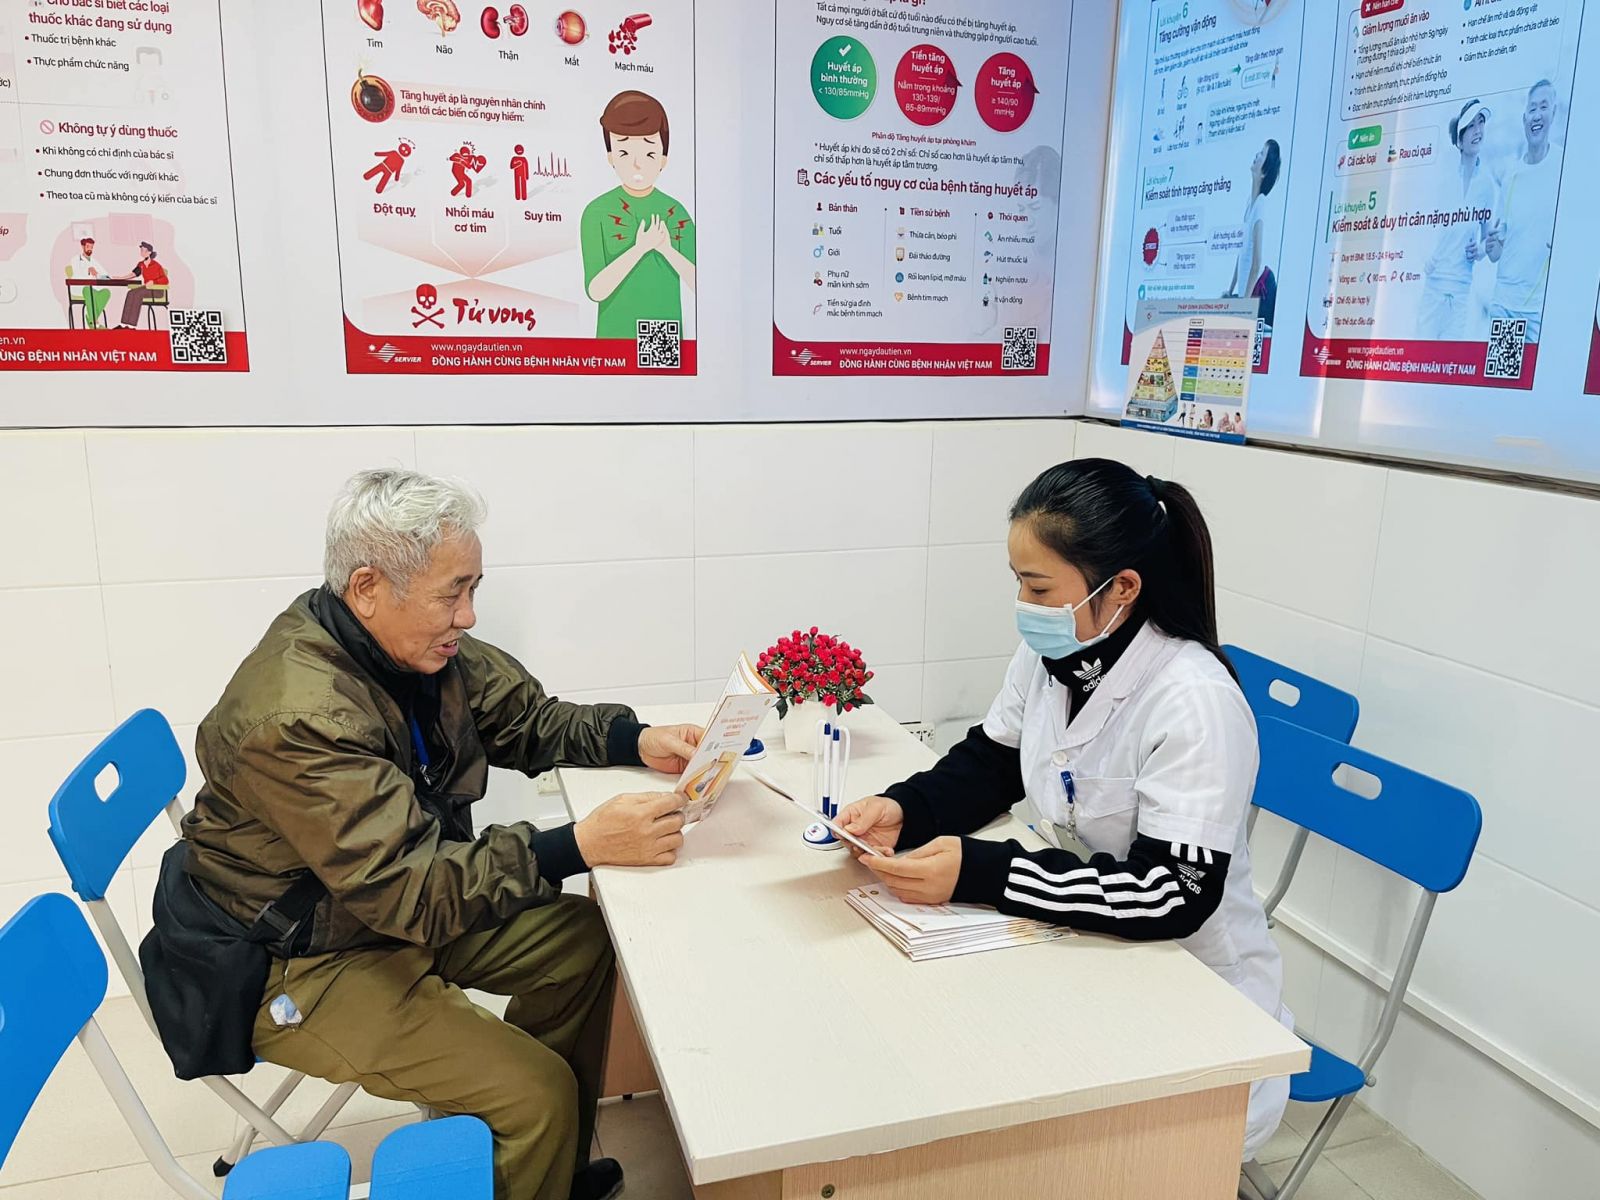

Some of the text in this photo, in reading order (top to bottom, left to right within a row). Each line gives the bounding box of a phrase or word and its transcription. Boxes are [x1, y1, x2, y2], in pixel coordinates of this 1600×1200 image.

[129, 1, 148, 11] các
[150, 1, 169, 14] loại
[29, 12, 172, 34] thuốc khác đang sử dụng
[31, 34, 116, 47] Thuốc trị bệnh khác
[367, 39, 382, 48] Tim
[436, 45, 452, 54] Não
[499, 50, 518, 60] Thận
[565, 56, 579, 66] Mắt
[911, 51, 946, 64] Tiền tăng
[33, 57, 129, 72] Thực phẩm chức năng
[615, 62, 653, 72] Mạch máu
[827, 62, 862, 74] Huyết áp
[912, 63, 943, 75] huyết áp
[998, 66, 1016, 78] Tăng
[820, 74, 868, 87] bình thường
[991, 78, 1022, 89] huyết áp
[825, 88, 869, 99] 130/85mmHg
[400, 90, 545, 110] Tăng huyết áp là nguyên nhân chính
[997, 97, 1019, 106] 140/90
[401, 104, 524, 122] dẫn tới các biến cố nguy hiểm:
[994, 109, 1015, 117] mmHg
[59, 122, 177, 138] Không tự ý dùng thuốc
[43, 146, 173, 159] Khi không có chỉ định của bác sĩ
[44, 169, 178, 181] Chung đơn thuốc với người khác
[814, 172, 1037, 199] Các yếu tố nguy cơ của bệnh tăng huyết áp
[46, 191, 68, 199] Theo
[85, 192, 95, 200] cũ
[97, 192, 110, 200] mà
[112, 192, 138, 203] không
[140, 194, 150, 202] có
[151, 194, 156, 204] ý
[158, 194, 175, 203] kiến
[177, 195, 192, 203] của
[194, 196, 208, 204] bác
[1344, 201, 1367, 214] khuyên
[1368, 191, 1377, 210] 5
[374, 203, 416, 217] Đột quỵ
[446, 205, 494, 218] Nhồi máu
[829, 203, 857, 212] Bản thân
[525, 211, 561, 223] Suy tim
[1332, 207, 1491, 232] Kiểm soát & duy trì cân nặng phù hợp
[455, 223, 486, 232] cơ tim
[453, 298, 536, 331] Tử vong
[431, 342, 522, 353] www.ngaydautien.vn
[840, 347, 912, 357] www.ngaydautien.vn
[0, 349, 156, 363] ÙNG BỆNH NHÂN VIỆT NAM
[432, 355, 625, 368] ĐỒNG HÀNH CÙNG BỆNH NHÂN VIỆT NAM
[840, 358, 992, 370] ĐỒNG HÀNH CÙNG BỆNH NHÂN VIỆT NAM
